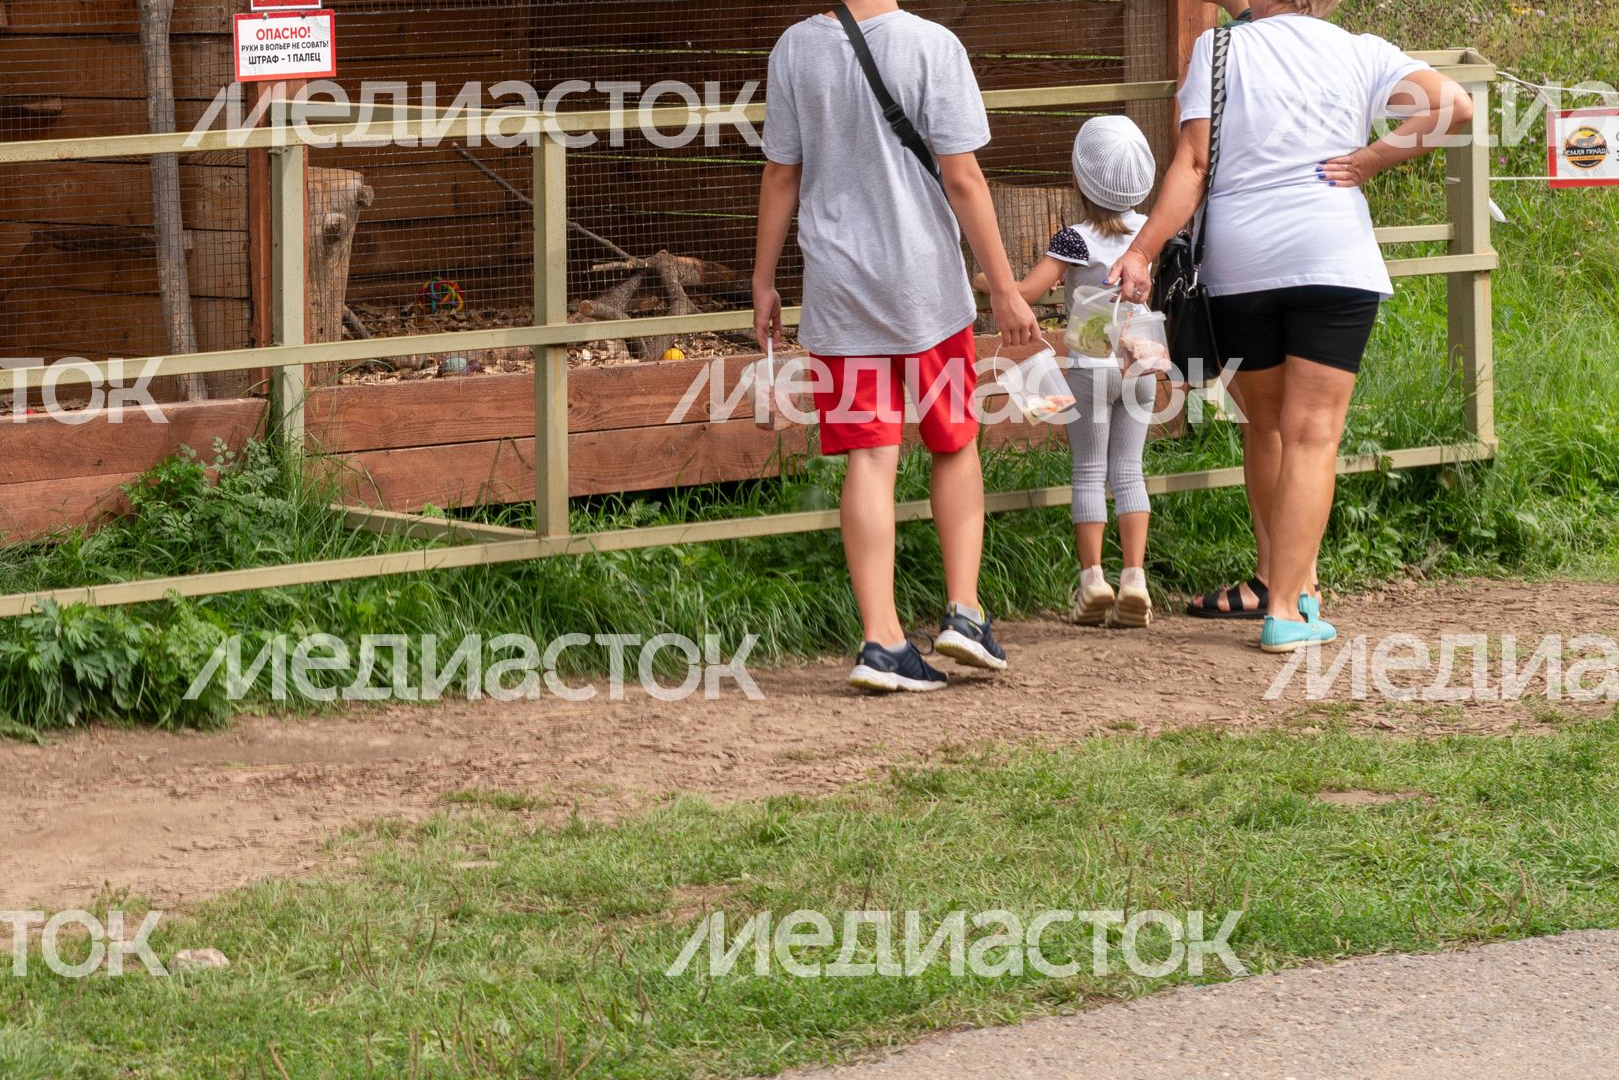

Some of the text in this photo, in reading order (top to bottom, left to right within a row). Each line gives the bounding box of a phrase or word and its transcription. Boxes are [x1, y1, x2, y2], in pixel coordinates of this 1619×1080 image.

[256, 26, 311, 41] ОПАСНО!
[266, 43, 290, 51] ВОЛЬЕР
[292, 42, 300, 50] НЕ
[301, 40, 329, 49] СОВАТЬ!
[249, 55, 279, 65] ШТРАФ
[287, 54, 291, 62] 1
[293, 53, 321, 62] ПАЛЕЦ
